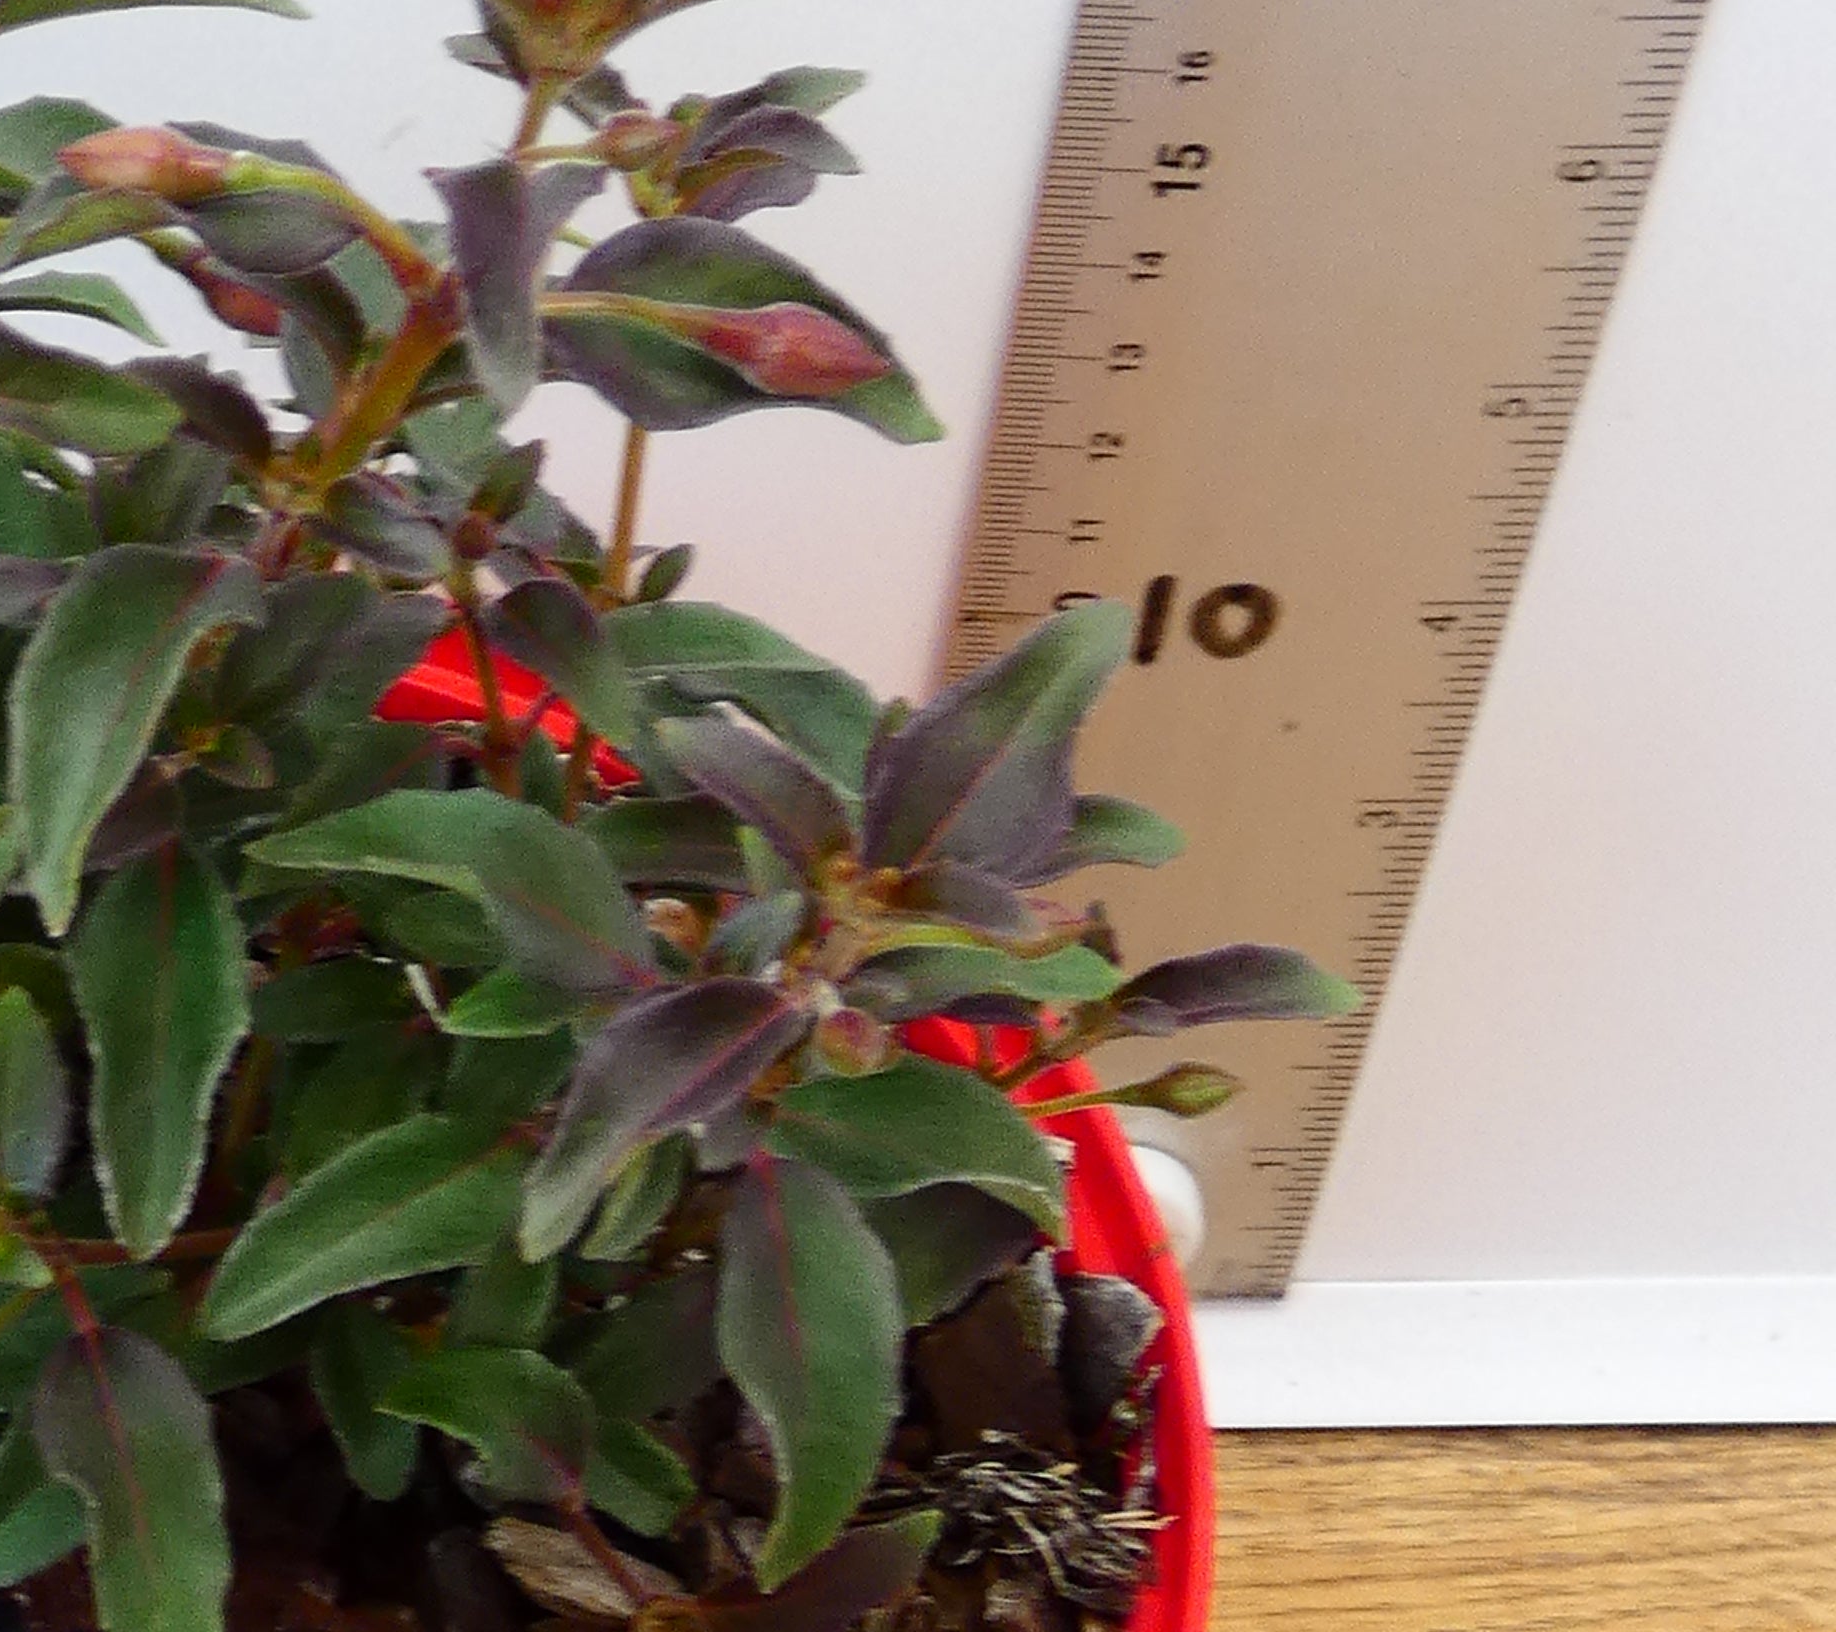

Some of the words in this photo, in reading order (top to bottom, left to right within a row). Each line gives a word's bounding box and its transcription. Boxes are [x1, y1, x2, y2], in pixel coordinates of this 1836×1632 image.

[1176, 51, 1213, 85] 16
[1150, 142, 1214, 198] 15
[1558, 158, 1606, 184] 6
[1128, 252, 1168, 283] 14
[1106, 344, 1145, 372] 13
[1482, 396, 1532, 419] 5
[1089, 433, 1126, 462] 12
[1068, 520, 1105, 545] 11
[1131, 576, 1280, 667] 10
[1420, 615, 1461, 633] 4
